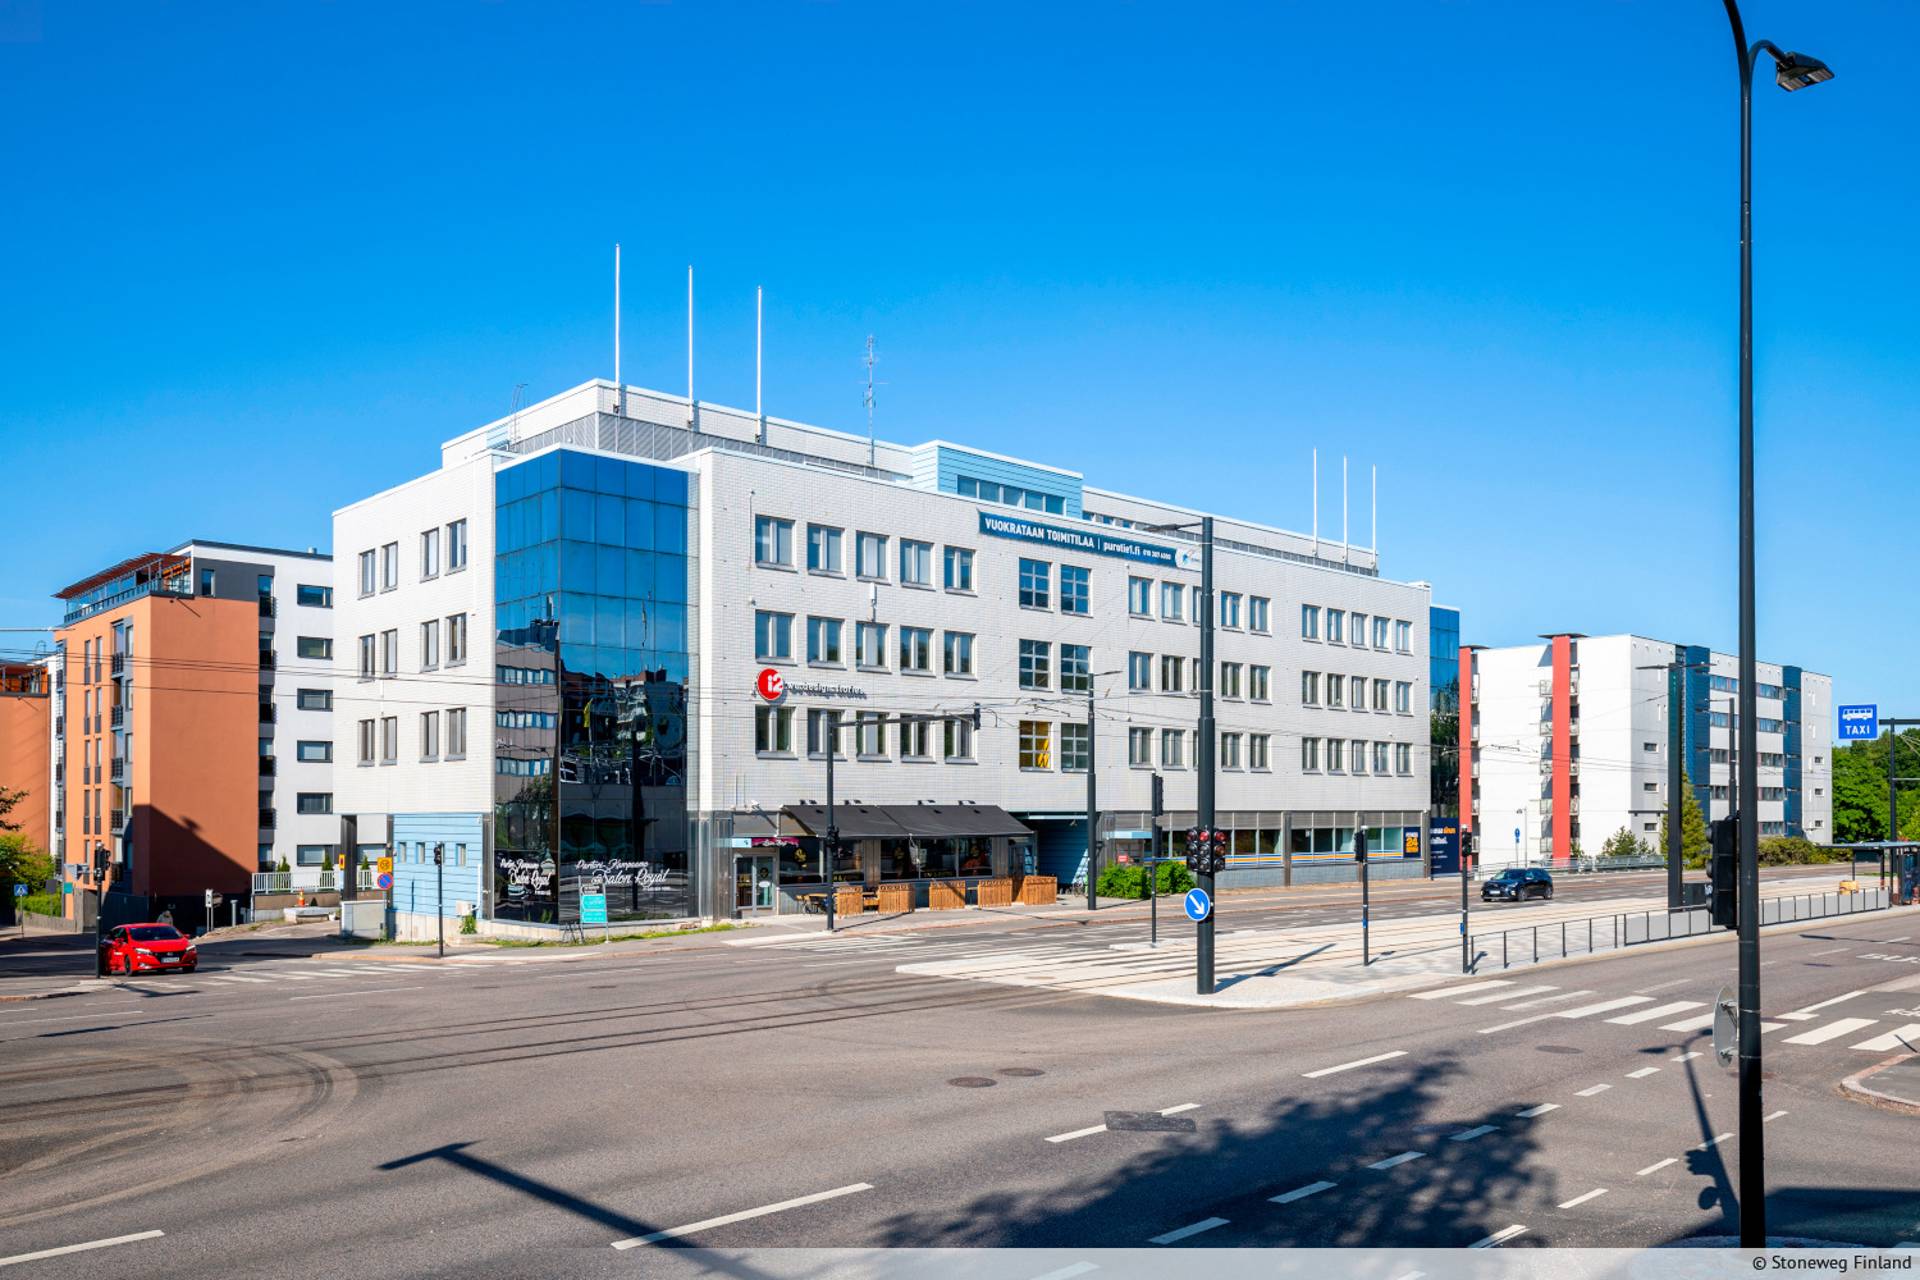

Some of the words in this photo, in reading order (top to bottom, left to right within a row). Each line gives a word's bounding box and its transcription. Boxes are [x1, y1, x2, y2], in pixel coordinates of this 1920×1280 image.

[985, 518, 1044, 539] VUOKRATAAN
[1047, 530, 1095, 548] TOIMITILAA
[1845, 725, 1870, 735] TAXI
[591, 869, 633, 885] Salon
[635, 868, 670, 889] Royal
